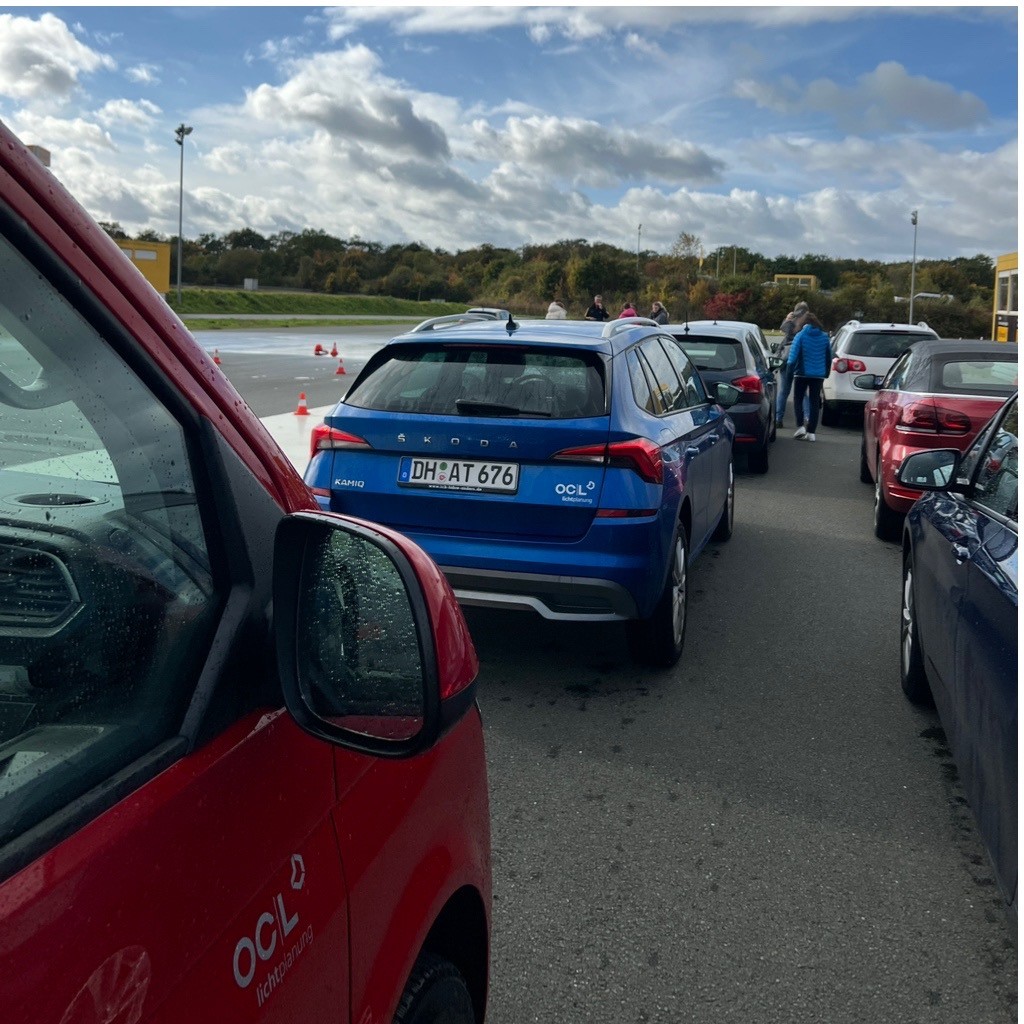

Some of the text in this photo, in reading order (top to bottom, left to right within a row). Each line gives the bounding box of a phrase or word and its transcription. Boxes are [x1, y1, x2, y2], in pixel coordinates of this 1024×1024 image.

[397, 433, 518, 449] ŠKODA
[411, 461, 513, 485] DH AT 676
[334, 478, 365, 488] KAMIQ
[562, 496, 593, 504] lichtplanung
[256, 924, 314, 1007] lichtplanung
